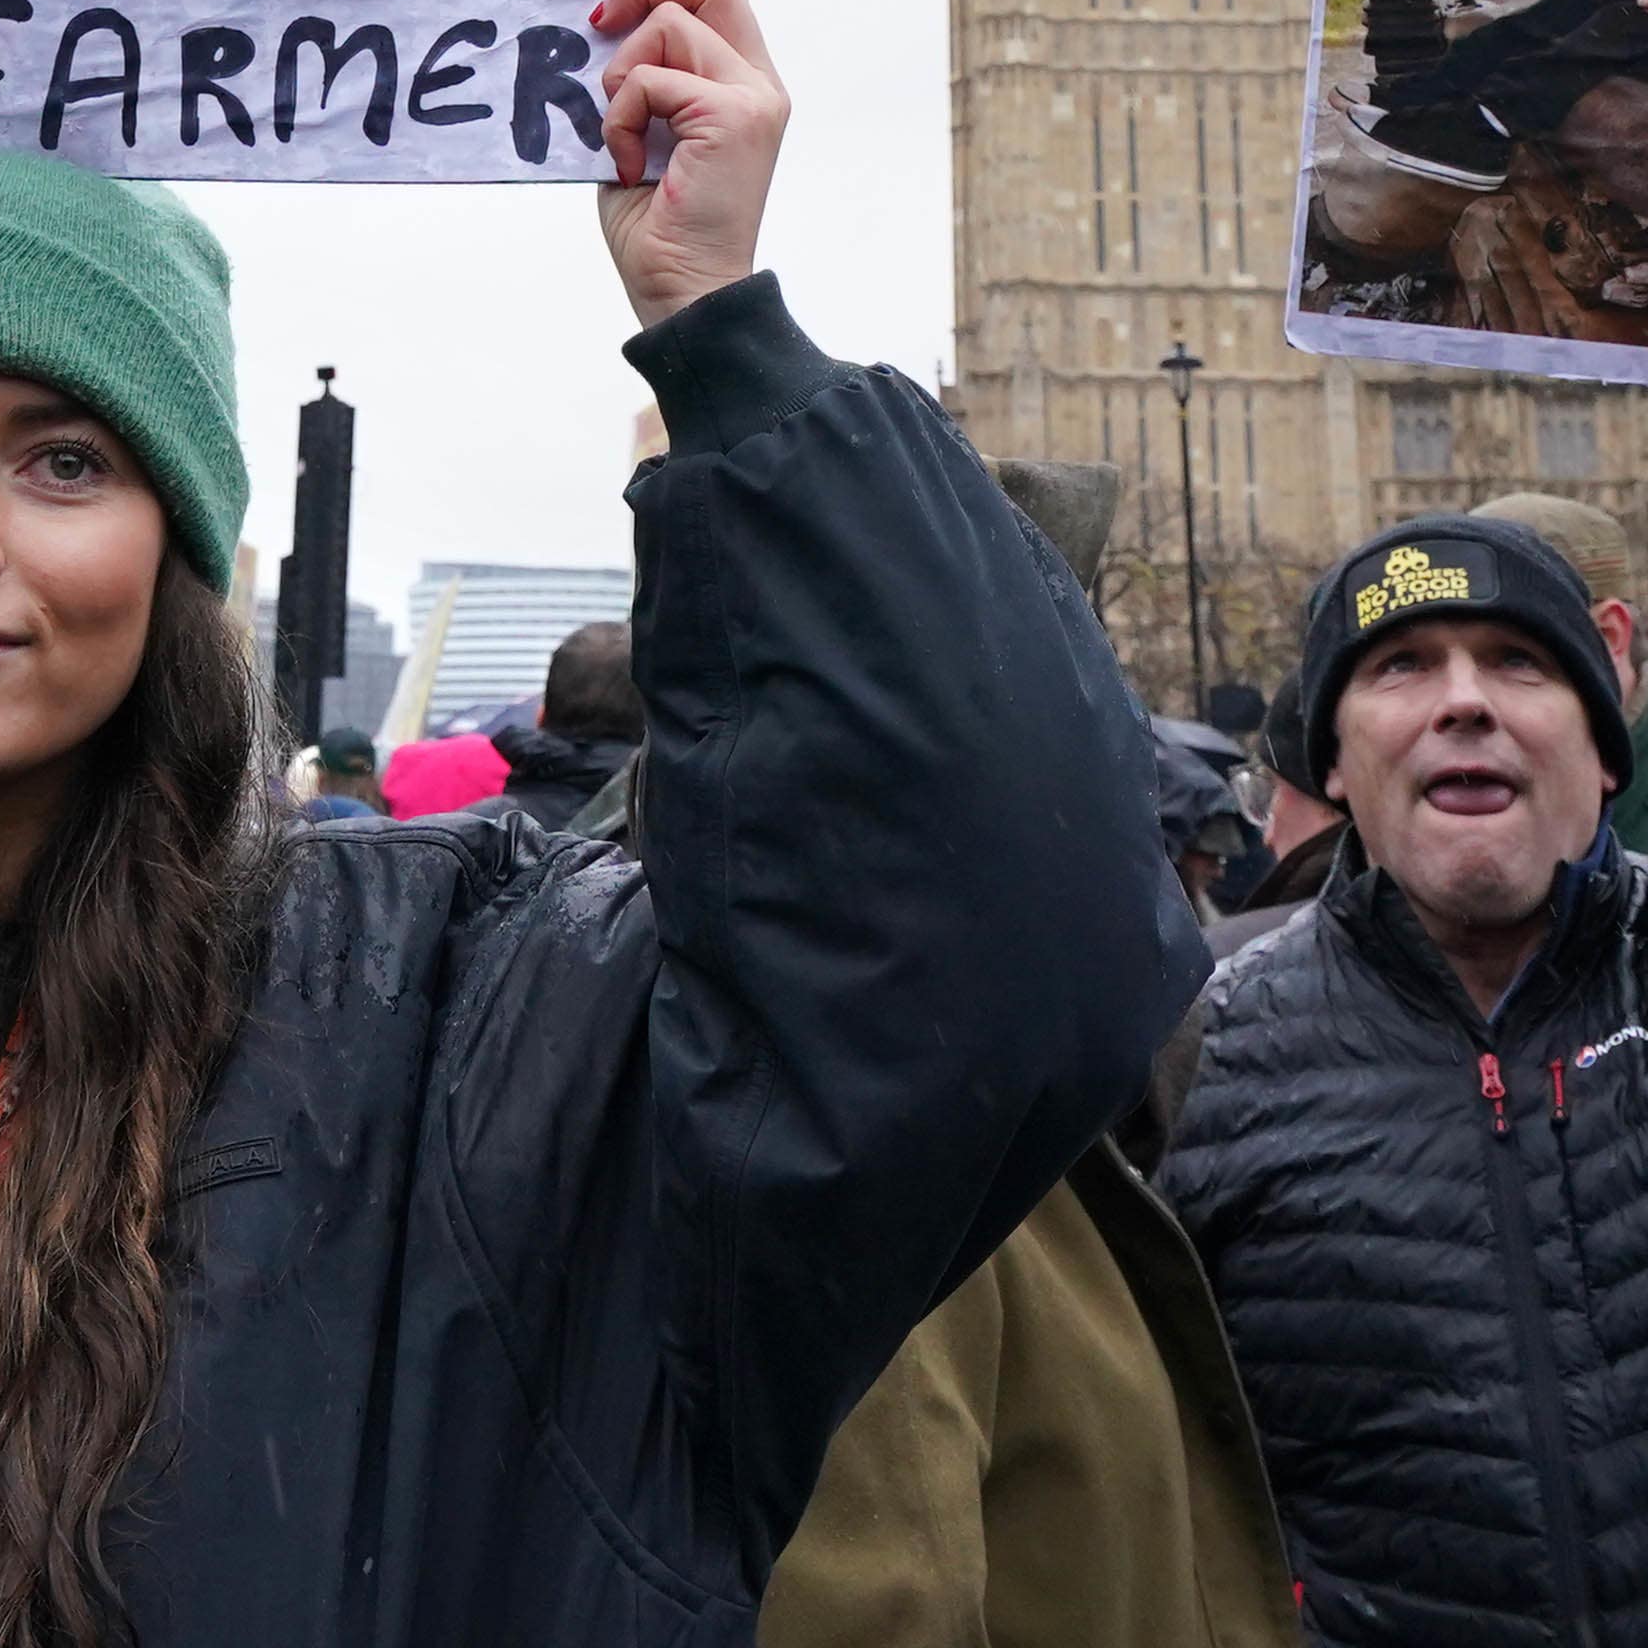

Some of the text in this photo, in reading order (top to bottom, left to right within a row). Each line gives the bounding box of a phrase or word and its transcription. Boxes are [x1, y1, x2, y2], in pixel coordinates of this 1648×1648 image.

[1356, 568, 1468, 604] NO FARMERS
[1357, 576, 1469, 617] NO FOOD
[1358, 589, 1470, 629] NO FUTURE
